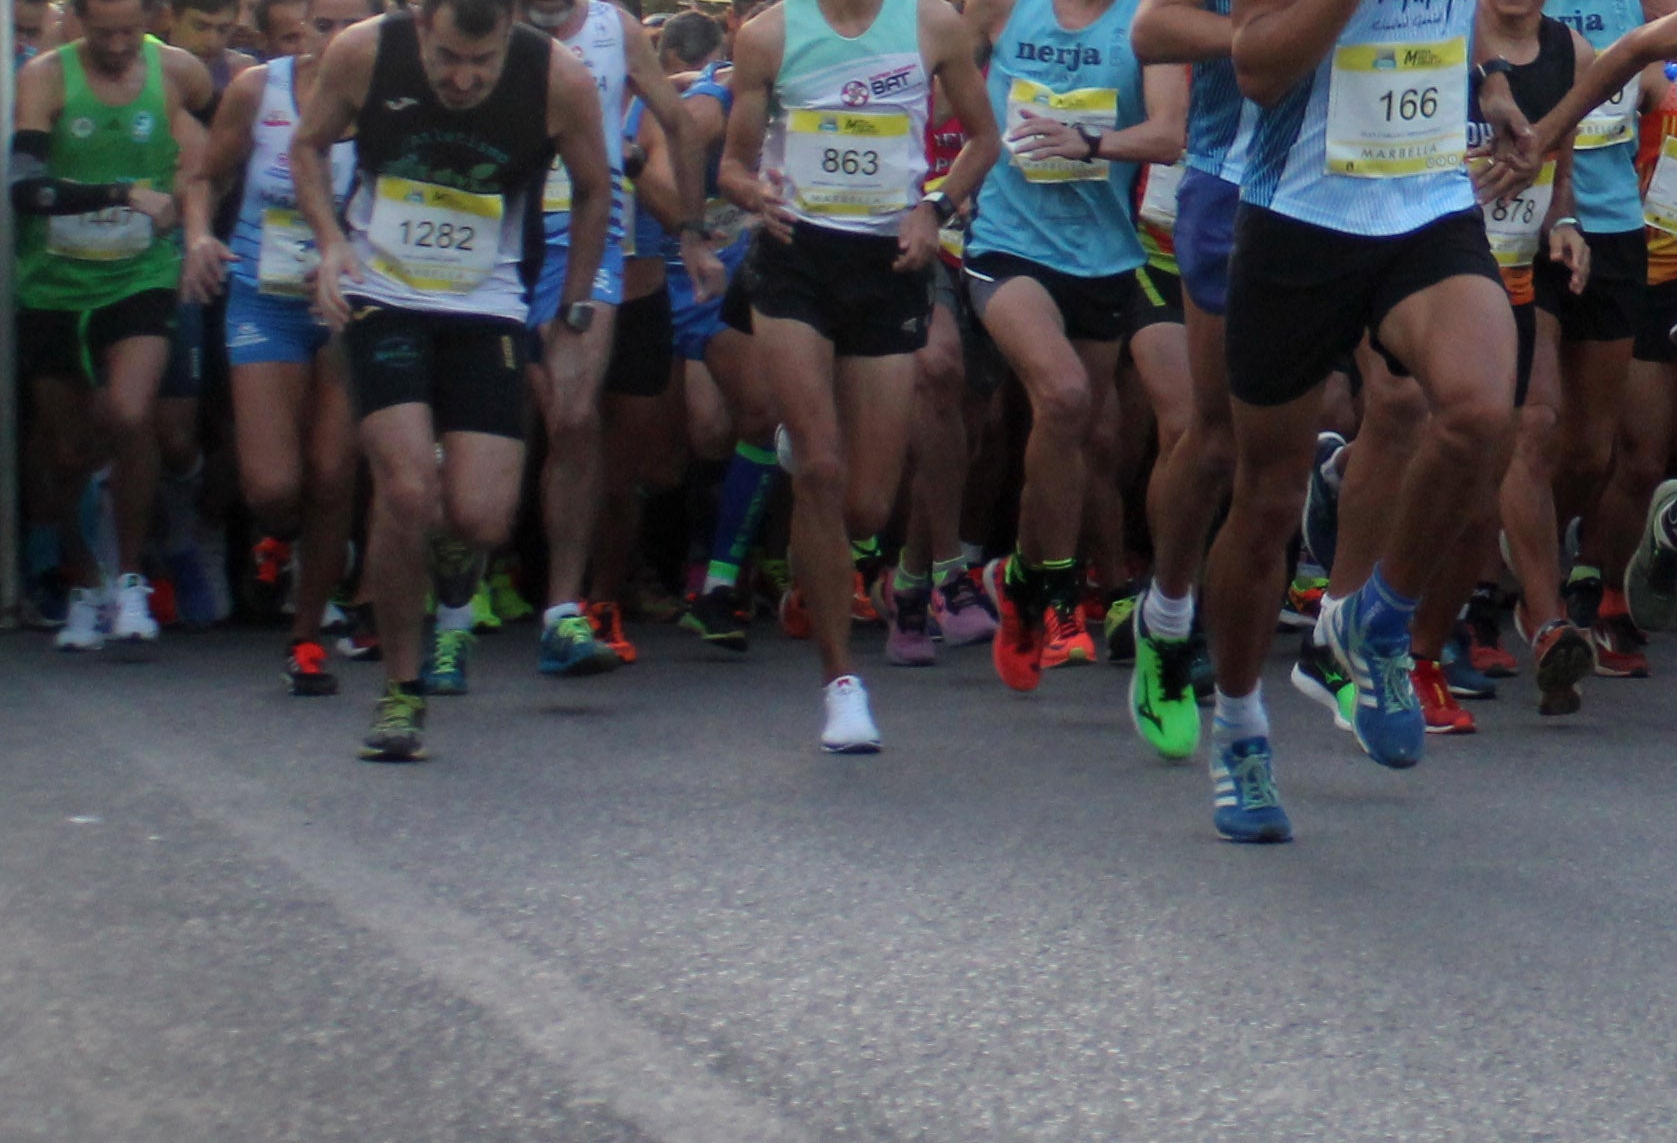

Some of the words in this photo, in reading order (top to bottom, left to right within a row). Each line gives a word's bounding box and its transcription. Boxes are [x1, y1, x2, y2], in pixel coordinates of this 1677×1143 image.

[1561, 10, 1605, 35] rja
[1015, 41, 1102, 72] nerja
[870, 72, 910, 95] BAT
[1379, 87, 1439, 122] 166
[822, 148, 878, 176] 863
[1360, 143, 1438, 160] MARBELLA
[400, 219, 475, 251] 1282
